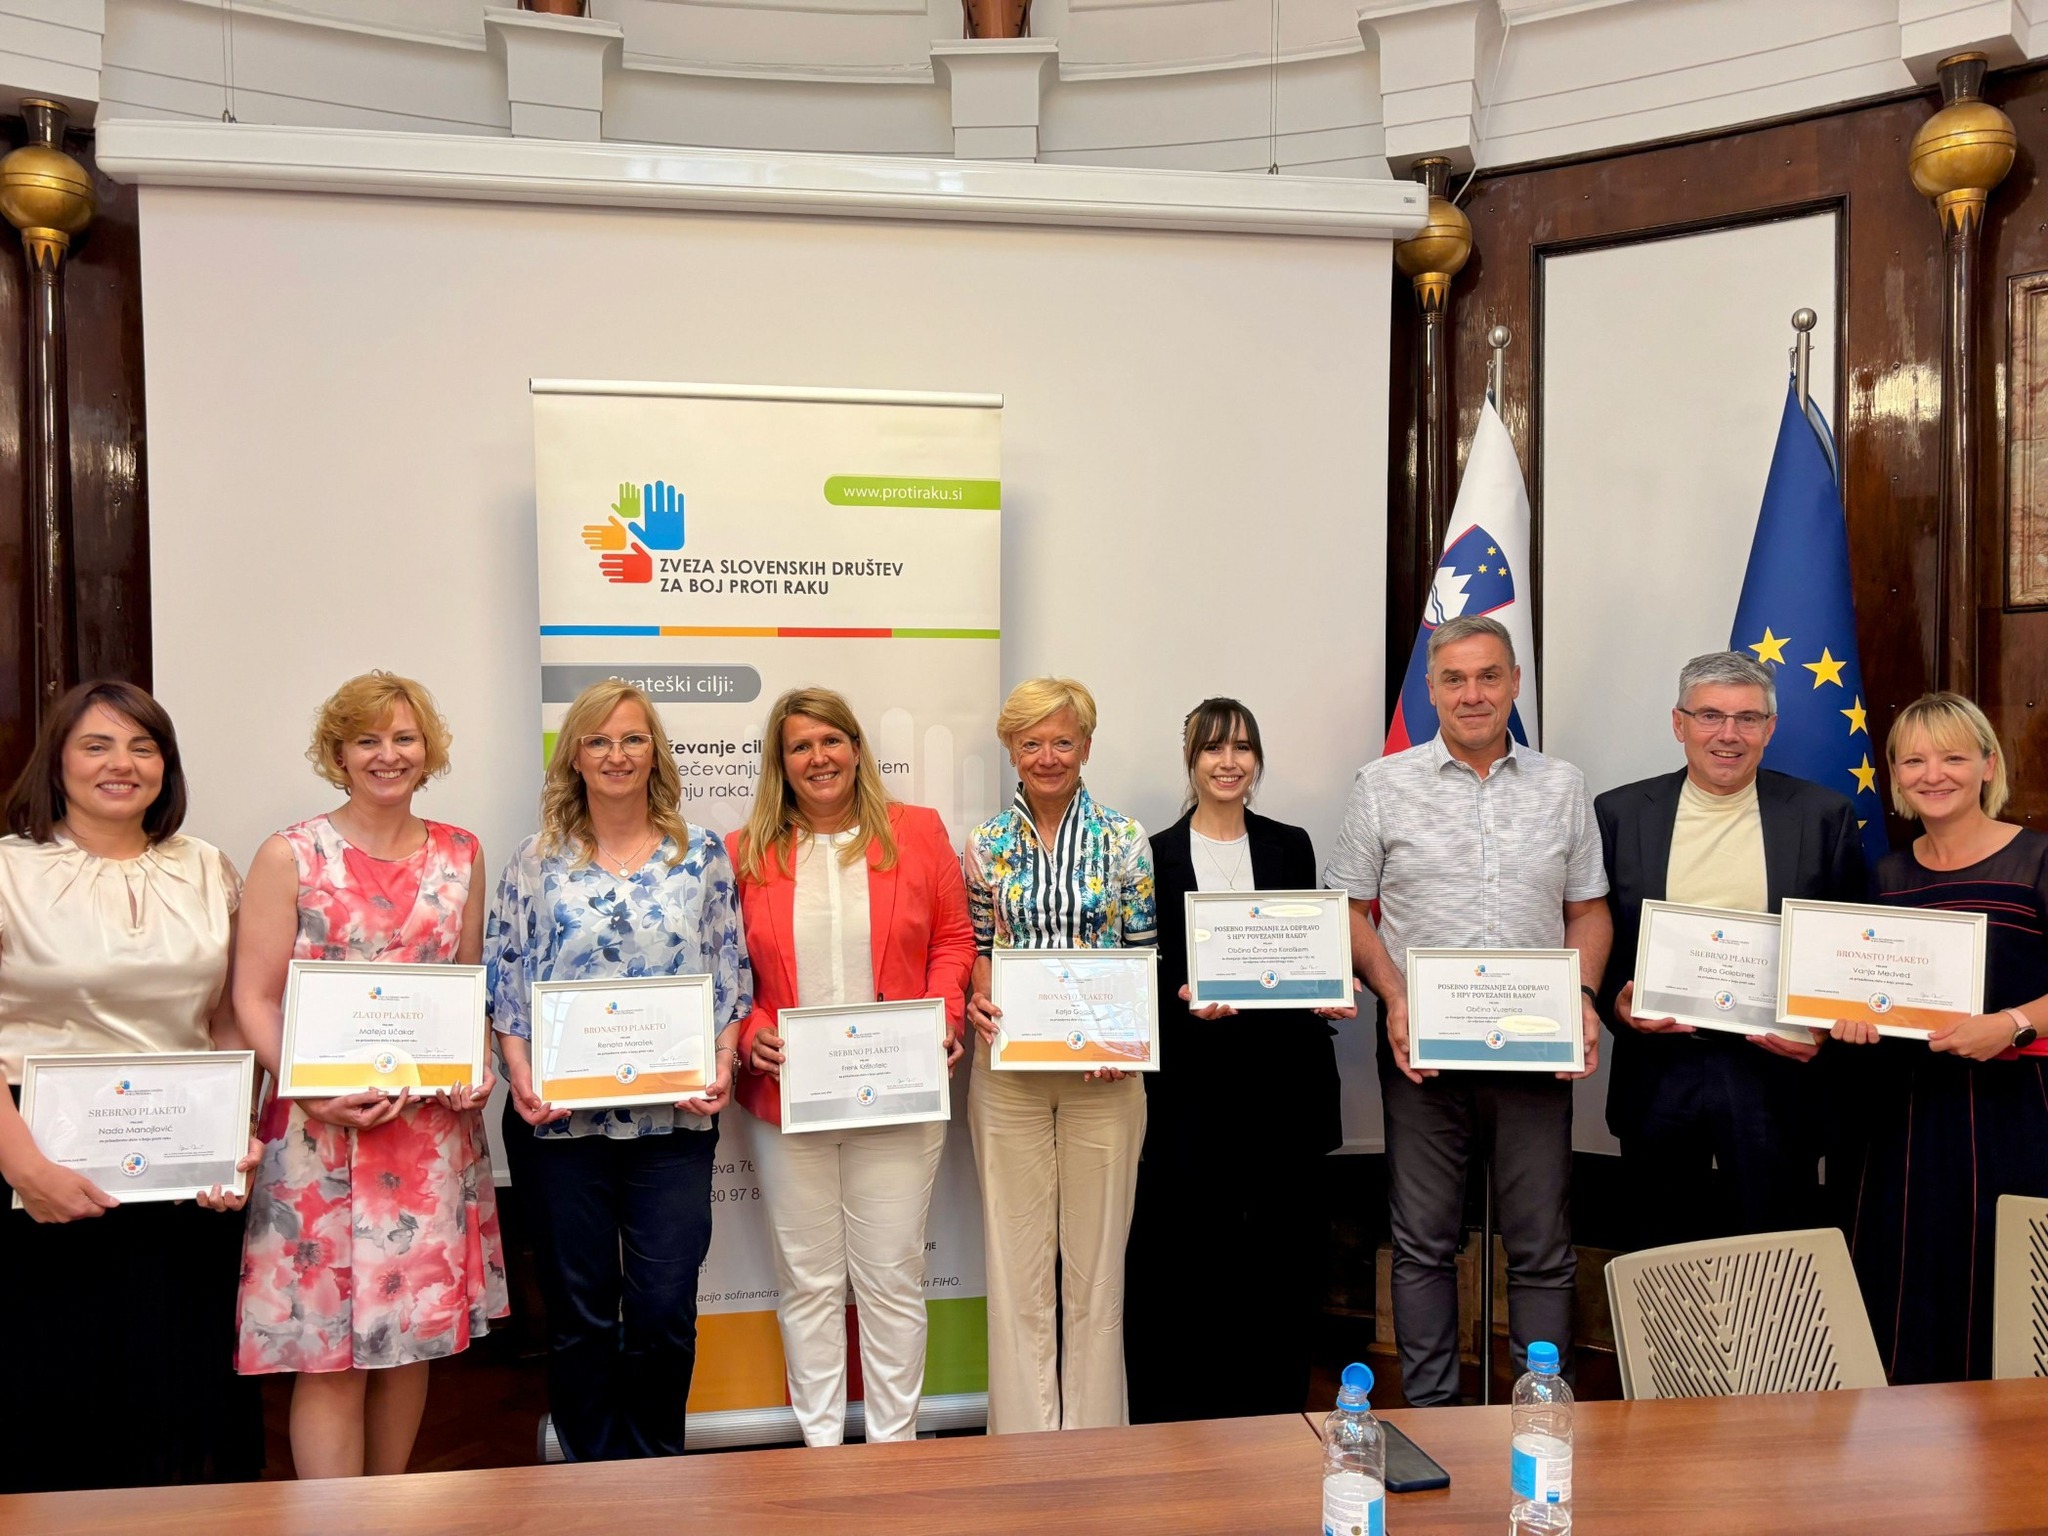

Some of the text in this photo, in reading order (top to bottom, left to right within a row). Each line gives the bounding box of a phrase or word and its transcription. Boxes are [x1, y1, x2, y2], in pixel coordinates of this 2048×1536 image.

[843, 486, 963, 501] www.protiraku.si
[660, 558, 903, 576] ZVEZA SLOVENSKIH DRUŠTEV
[660, 578, 829, 595] ZA BOJ PROTI RAKU
[609, 675, 734, 697] rateški cilji:
[667, 739, 762, 757] ževanje cil
[678, 759, 910, 779] ečevanju jem
[680, 783, 754, 801] nju raka.
[1245, 925, 1279, 933] PRIZNANJE
[1689, 949, 1769, 966] SREBRNO PLAKETO
[1836, 949, 1929, 966] BRONASTO PLAKETO
[1877, 970, 1911, 979] Medved
[352, 1010, 424, 1020] ZLATO PLAKETO
[583, 1022, 667, 1035] BRONASTO PLAKETO
[828, 1045, 900, 1058] SREBRNO PLAKETO
[88, 1105, 186, 1118] SREBRNO PLAKETO
[98, 1127, 124, 1135] Nada
[711, 1163, 735, 1174] eva
[729, 1188, 747, 1201] 97
[751, 1187, 760, 1200] 8
[932, 1277, 962, 1288] FIHO.
[697, 1289, 780, 1304] acijo sofinancira
